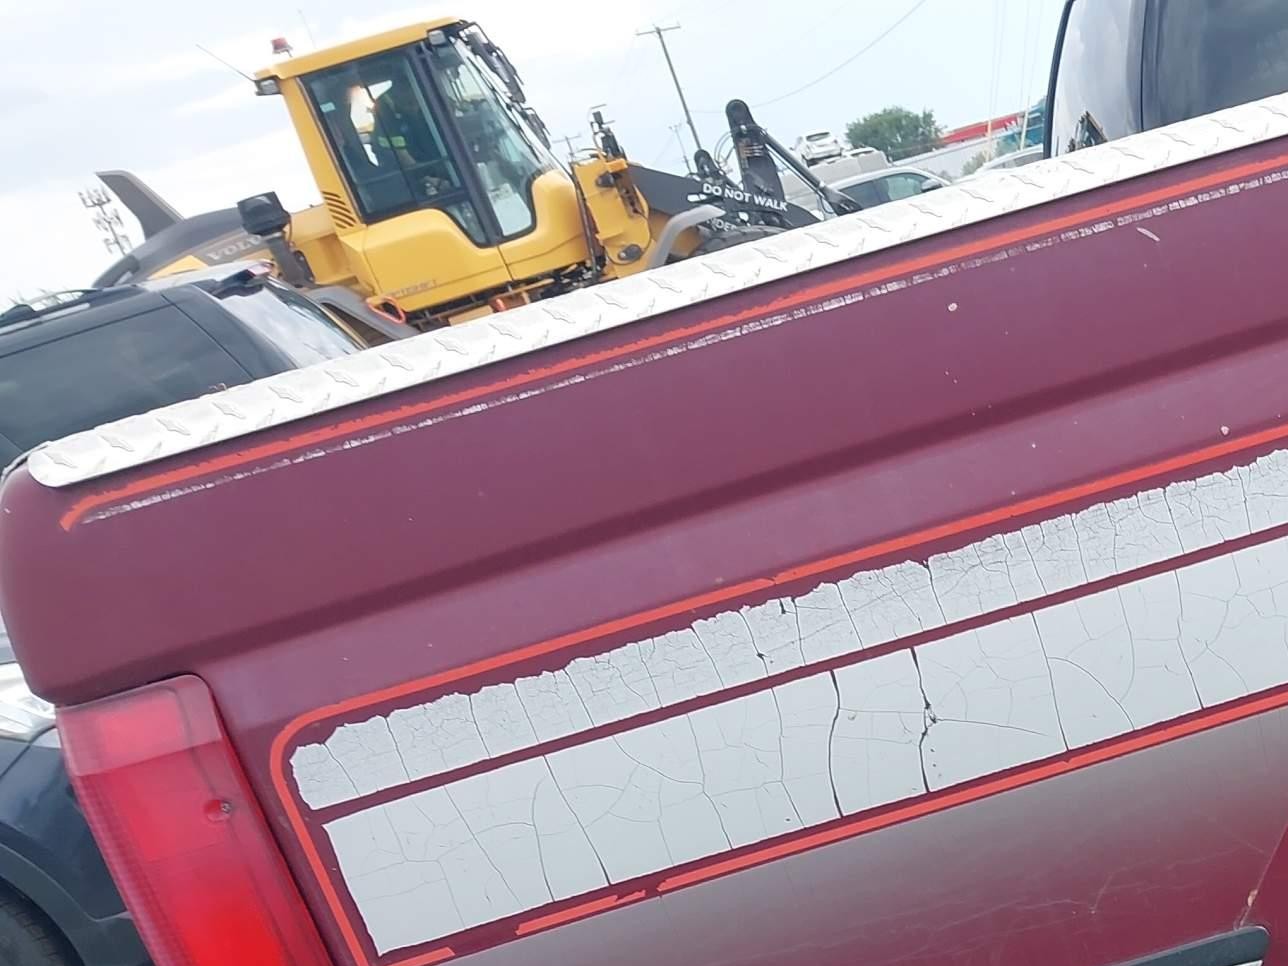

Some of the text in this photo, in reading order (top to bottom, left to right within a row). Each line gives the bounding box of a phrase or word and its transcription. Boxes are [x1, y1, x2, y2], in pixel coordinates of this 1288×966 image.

[702, 183, 788, 212] DO NOT WALK
[206, 234, 264, 260] VOLV
